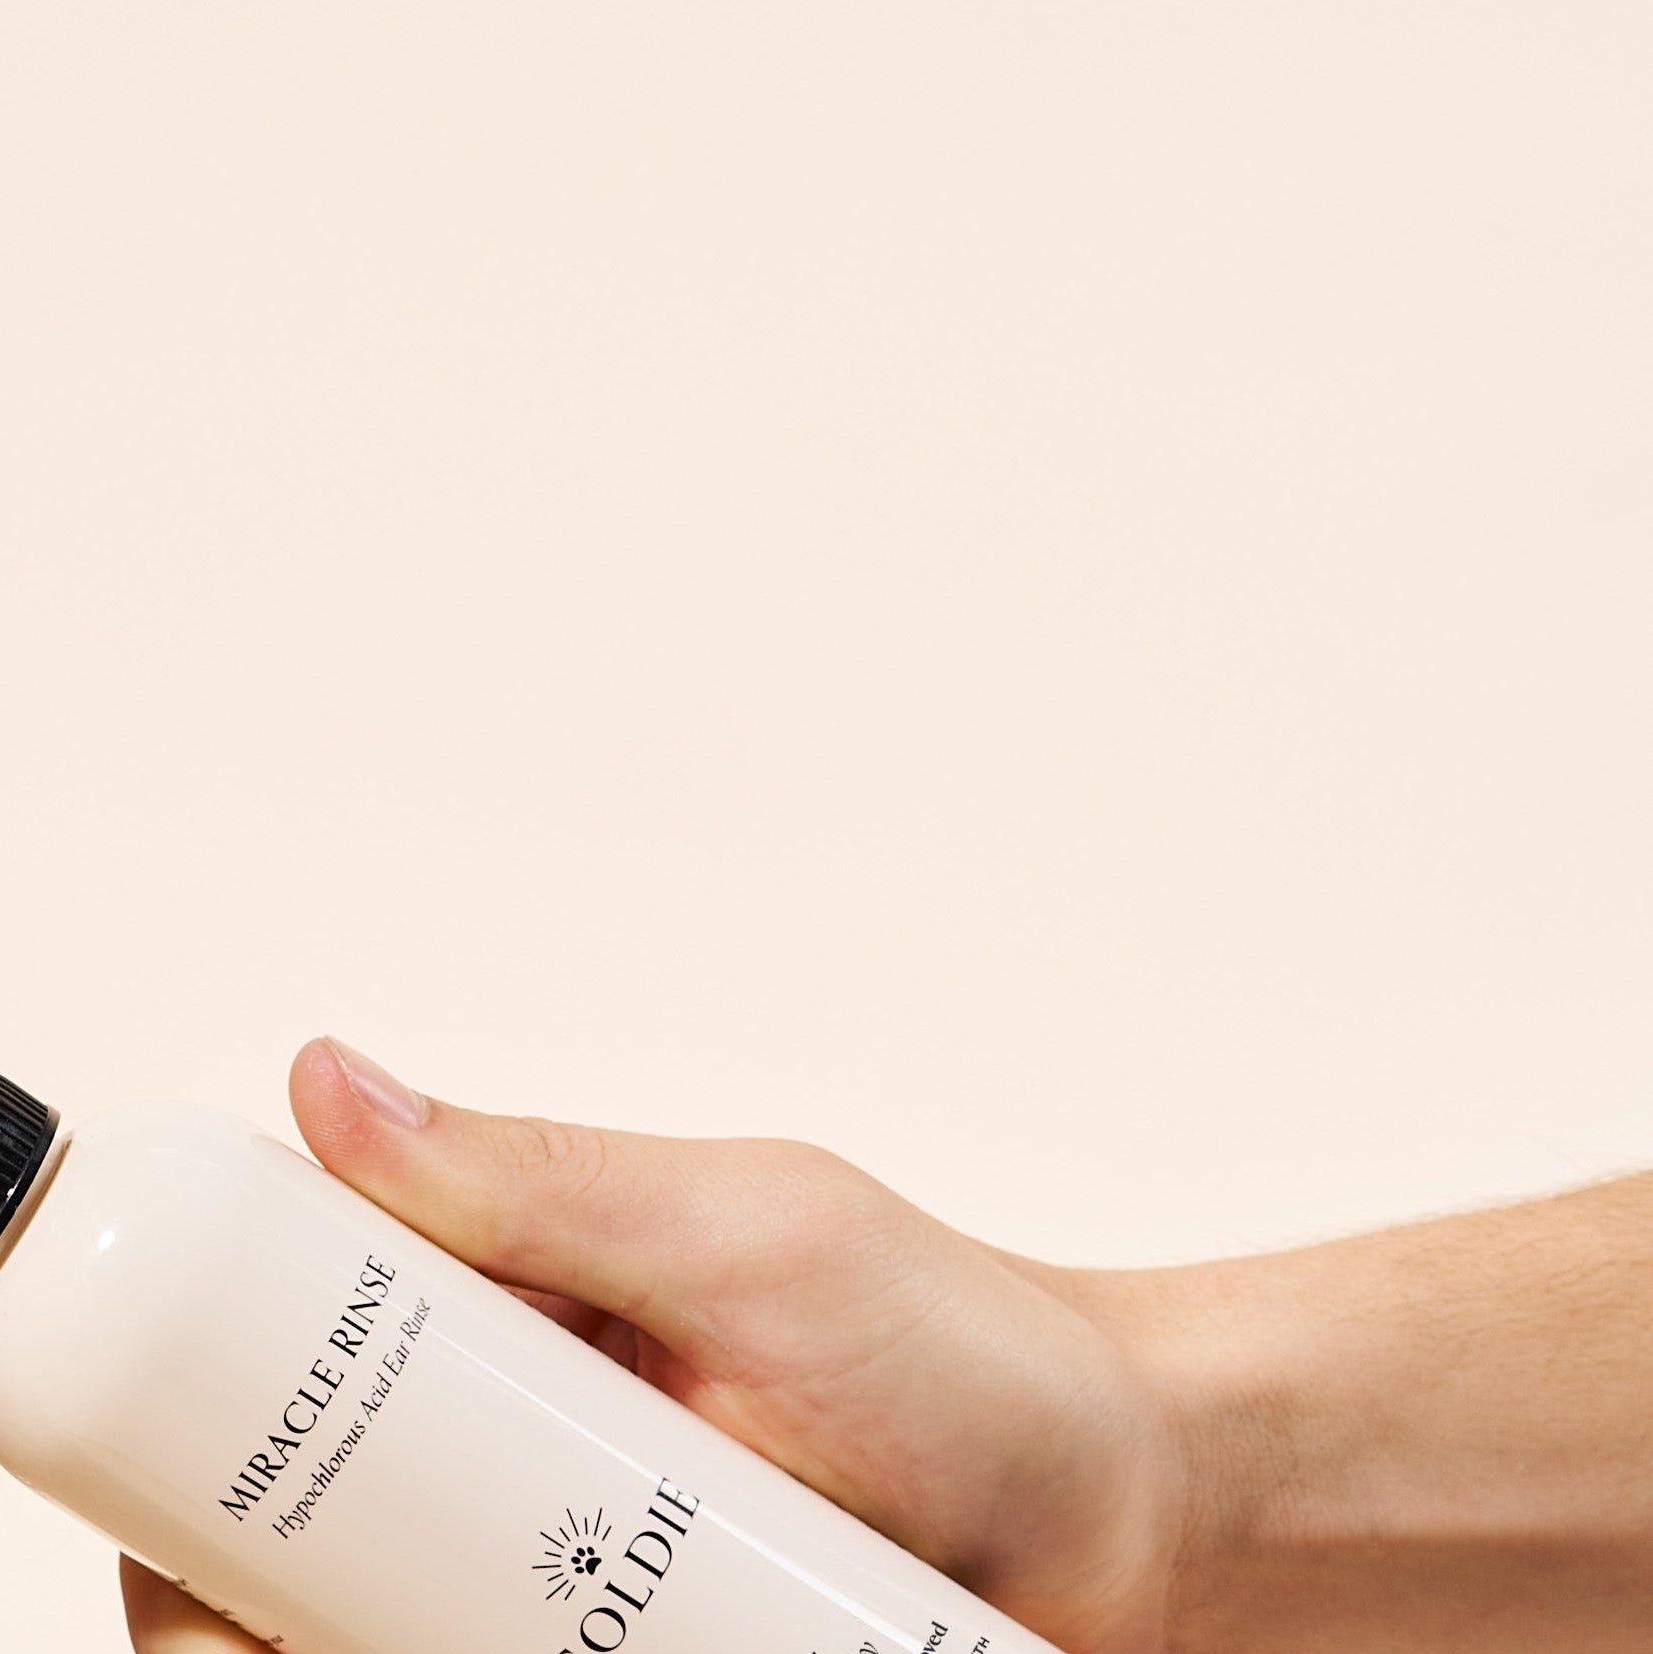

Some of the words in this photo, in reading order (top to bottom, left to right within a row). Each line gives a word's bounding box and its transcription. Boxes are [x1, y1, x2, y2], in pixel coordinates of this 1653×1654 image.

[217, 1358, 345, 1522] MIRACLE
[327, 1254, 396, 1360] RINSE
[271, 1420, 367, 1540] Hypochlorous
[360, 1371, 393, 1422] Acid
[382, 1340, 410, 1377] Ear
[399, 1297, 431, 1342] Rinse
